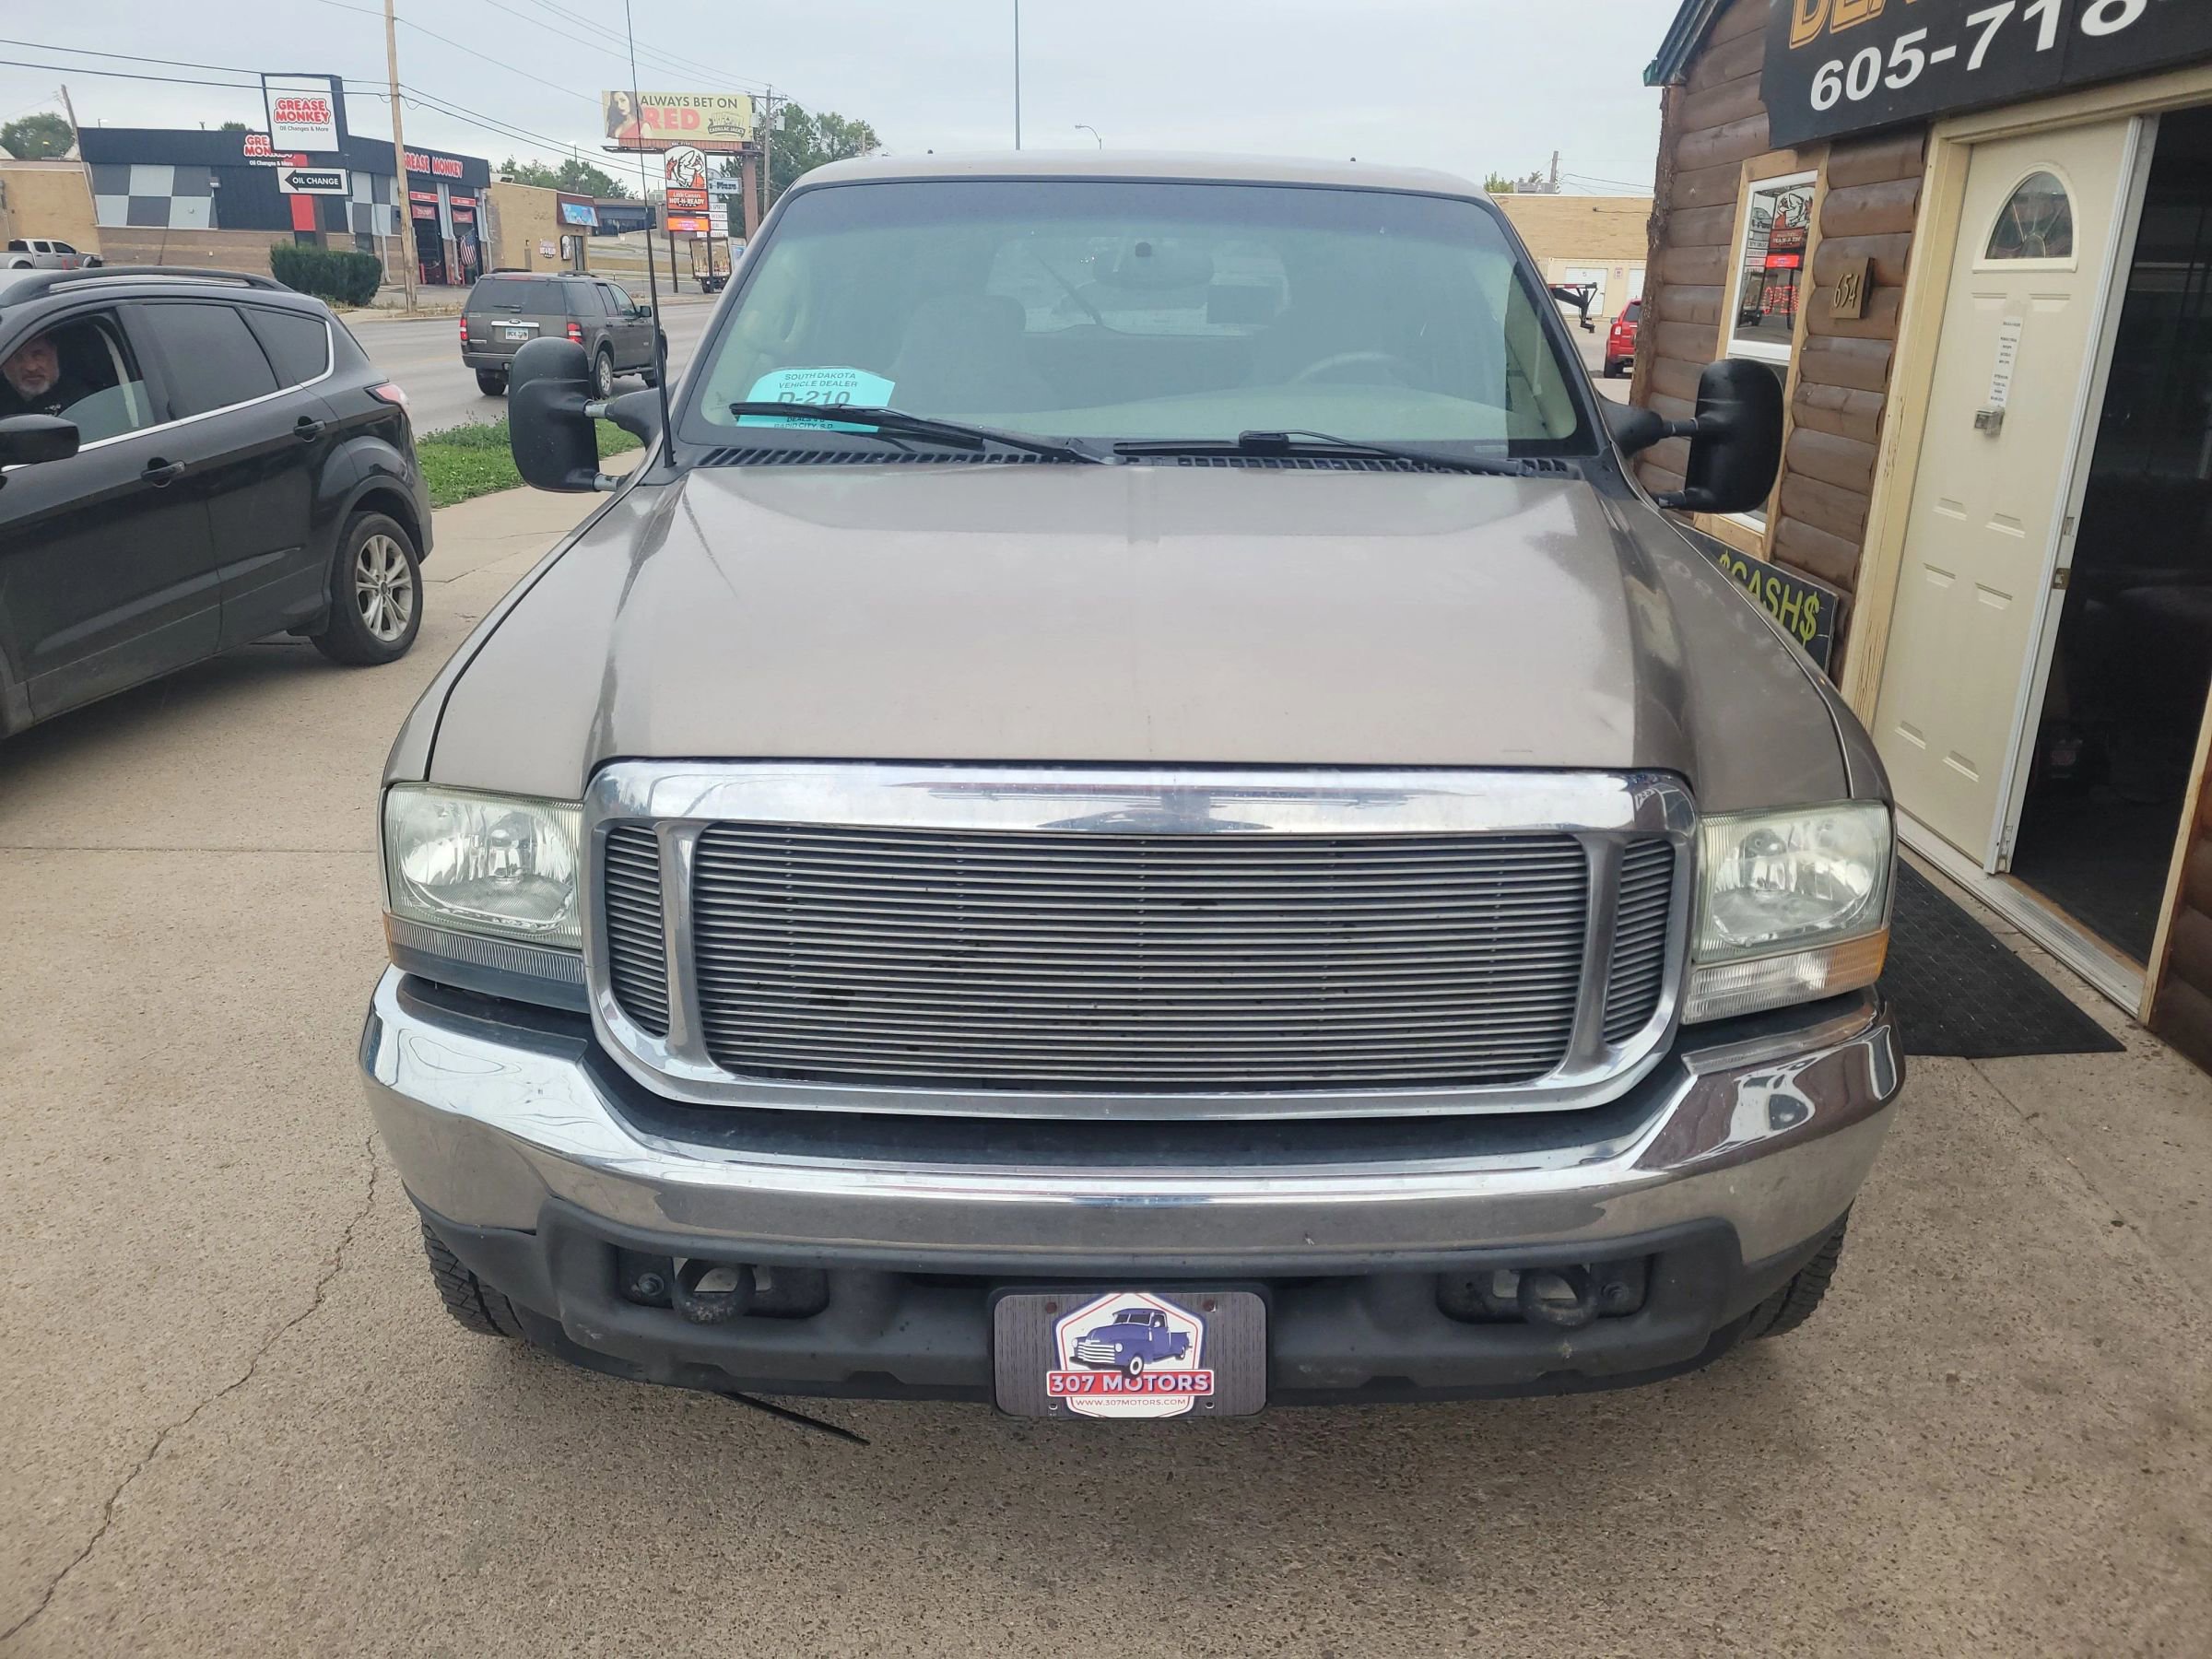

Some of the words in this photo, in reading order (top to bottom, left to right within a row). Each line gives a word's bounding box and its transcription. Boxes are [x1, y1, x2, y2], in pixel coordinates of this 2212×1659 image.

[276, 100, 325, 111] GREASE
[641, 95, 689, 107] ALWAYS
[693, 97, 714, 108] BET
[717, 98, 737, 109] ON
[276, 111, 329, 123] MONKEY
[642, 107, 700, 131] RED
[246, 135, 269, 146] GRE
[244, 146, 274, 156] MON
[405, 152, 429, 173] REASE
[432, 157, 463, 178] MONKEY
[1833, 273, 1860, 308] 654
[784, 372, 817, 381] SOUTH
[818, 371, 856, 380] DAKOTA
[779, 381, 818, 389] VEHICLE
[819, 380, 858, 388] DEALER
[778, 390, 851, 405] D-210
[1052, 1375, 1095, 1392] 307
[1103, 1374, 1209, 1392] MOTORS
